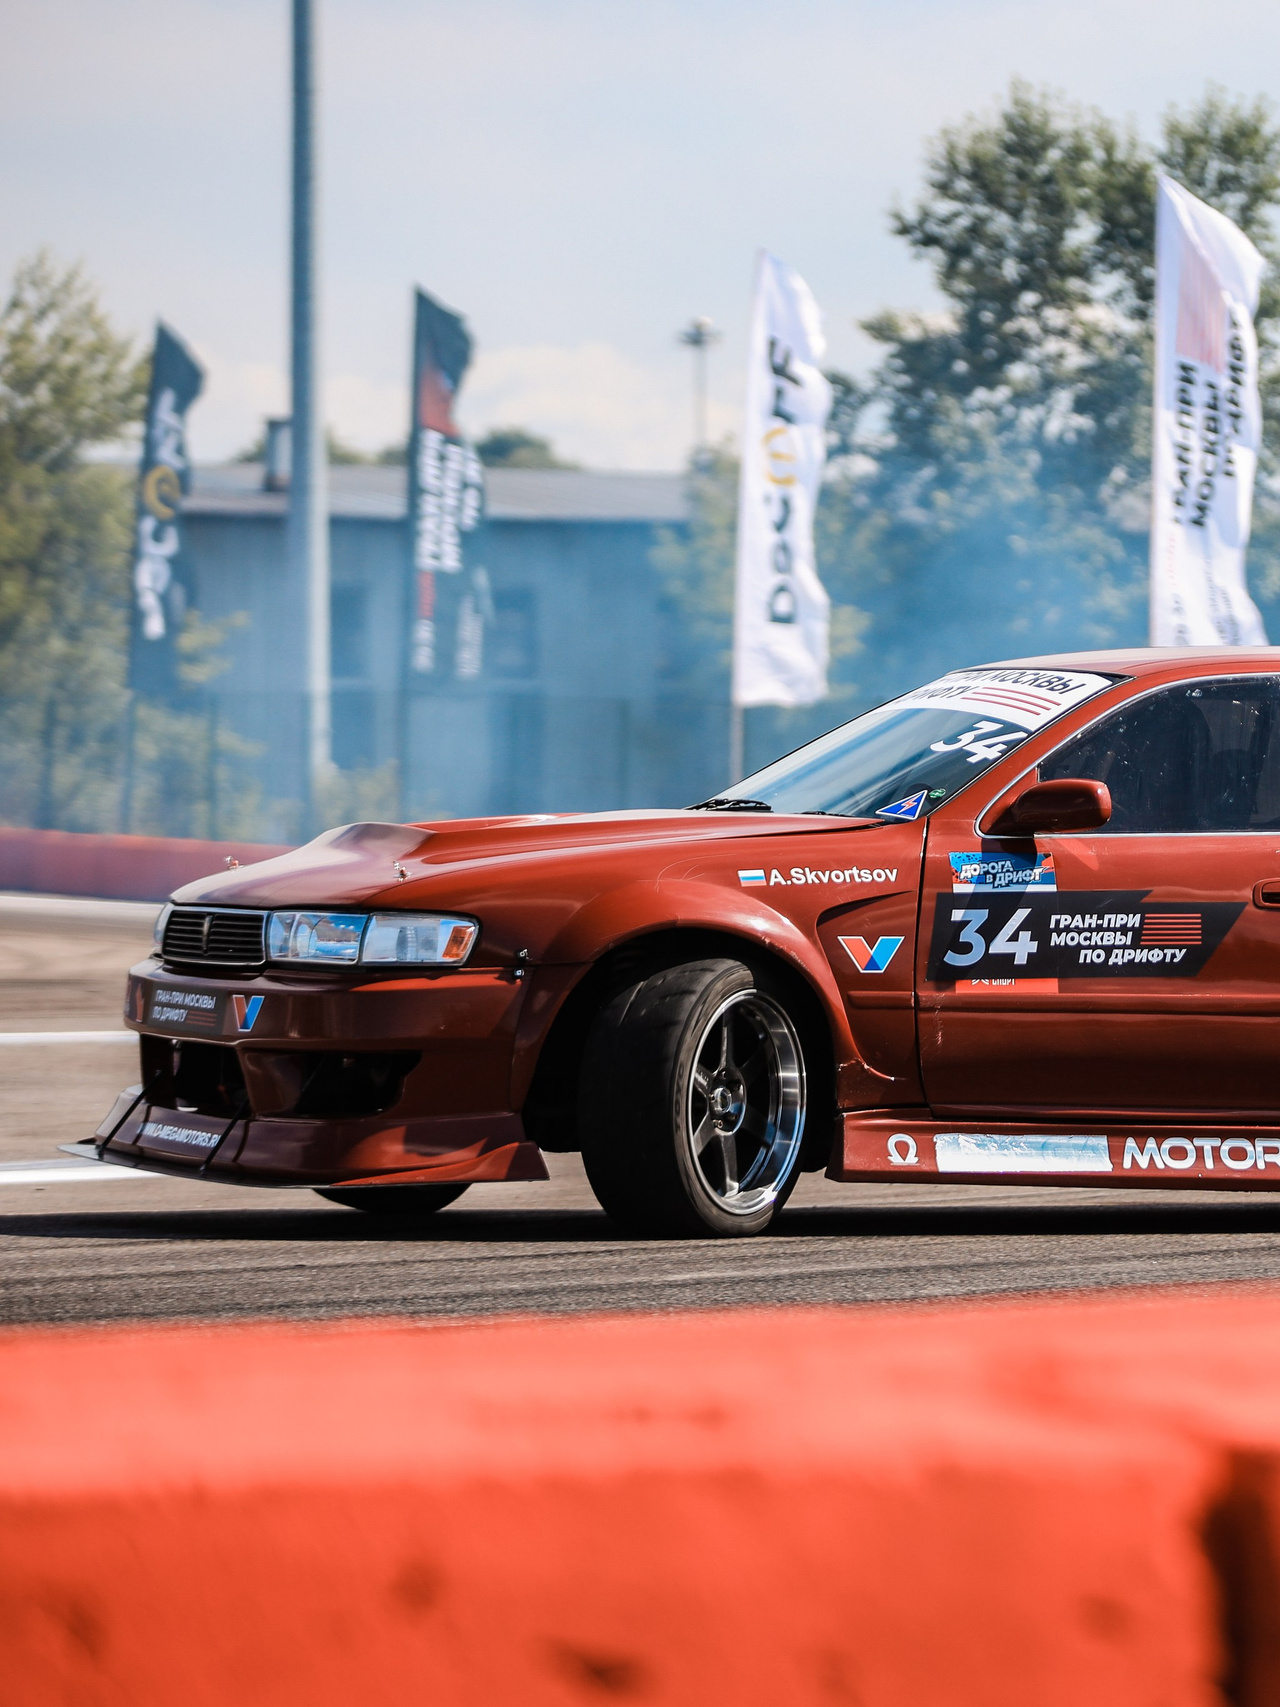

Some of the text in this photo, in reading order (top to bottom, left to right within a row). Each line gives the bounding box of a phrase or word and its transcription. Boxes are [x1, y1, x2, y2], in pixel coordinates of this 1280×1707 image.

[929, 720, 1029, 764] 34
[769, 867, 898, 886] A.Skvortsov
[960, 860, 1013, 880] ДОРОГА
[994, 867, 1044, 887] ДРИФТ
[1050, 914, 1141, 929] ГРАН-ПРИ
[943, 908, 1038, 967] 34
[1050, 932, 1132, 946] МОСКВЫ
[1079, 949, 1187, 965] ПО ДРИФТУ
[184, 993, 217, 1009] МОСКВЫ
